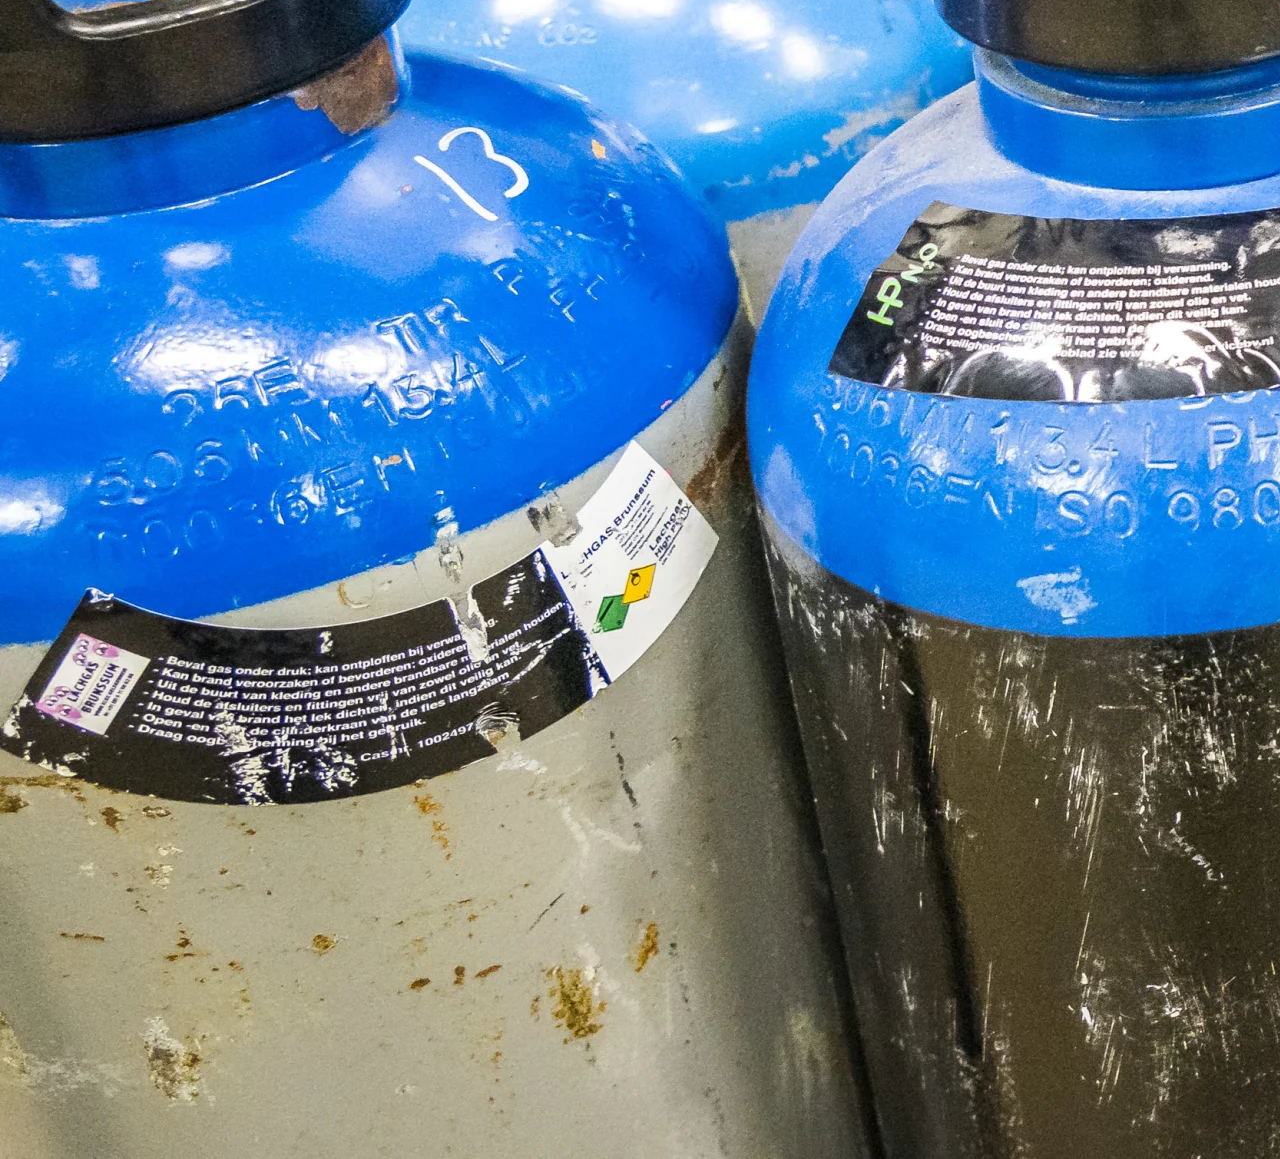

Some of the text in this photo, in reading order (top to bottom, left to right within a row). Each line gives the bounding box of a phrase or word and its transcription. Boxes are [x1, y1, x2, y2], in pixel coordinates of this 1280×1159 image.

[412, 126, 530, 222] 13
[954, 265, 1214, 287] Kan brand veroorzaken of bevorderen; oxiderend.
[961, 254, 1231, 276] Bevat gas onder druk; kan ontploffen bij verwarming.
[613, 469, 656, 527] Brunssum
[649, 498, 683, 551] Lachgas
[158, 602, 566, 700] Uit de buurt van kleding en andere brandbare houden.
[166, 648, 423, 676] Bevat gas onder druk; kan ontploffen bij
[67, 661, 99, 702] LACHGAS
[81, 663, 120, 713] BRUNSSUM
[147, 654, 522, 724] In geval brand het lek dichten, indien dit veilig kan.
[152, 690, 190, 705] Houd
[194, 699, 212, 708] de
[215, 702, 281, 712] afsluiters
[285, 703, 303, 712] en
[306, 697, 363, 711] fittingen
[393, 686, 416, 696] van
[420, 672, 455, 689] zowel
[161, 662, 416, 689] Kan brand veroorzaken of bevorderen;
[143, 713, 182, 728] Open
[250, 727, 269, 736] de
[372, 715, 396, 726] van
[401, 706, 418, 718] de
[421, 698, 446, 714] fles
[449, 672, 510, 703] langzaam
[138, 718, 426, 745] Draag bij het gebruik.
[360, 751, 386, 762] Cas
